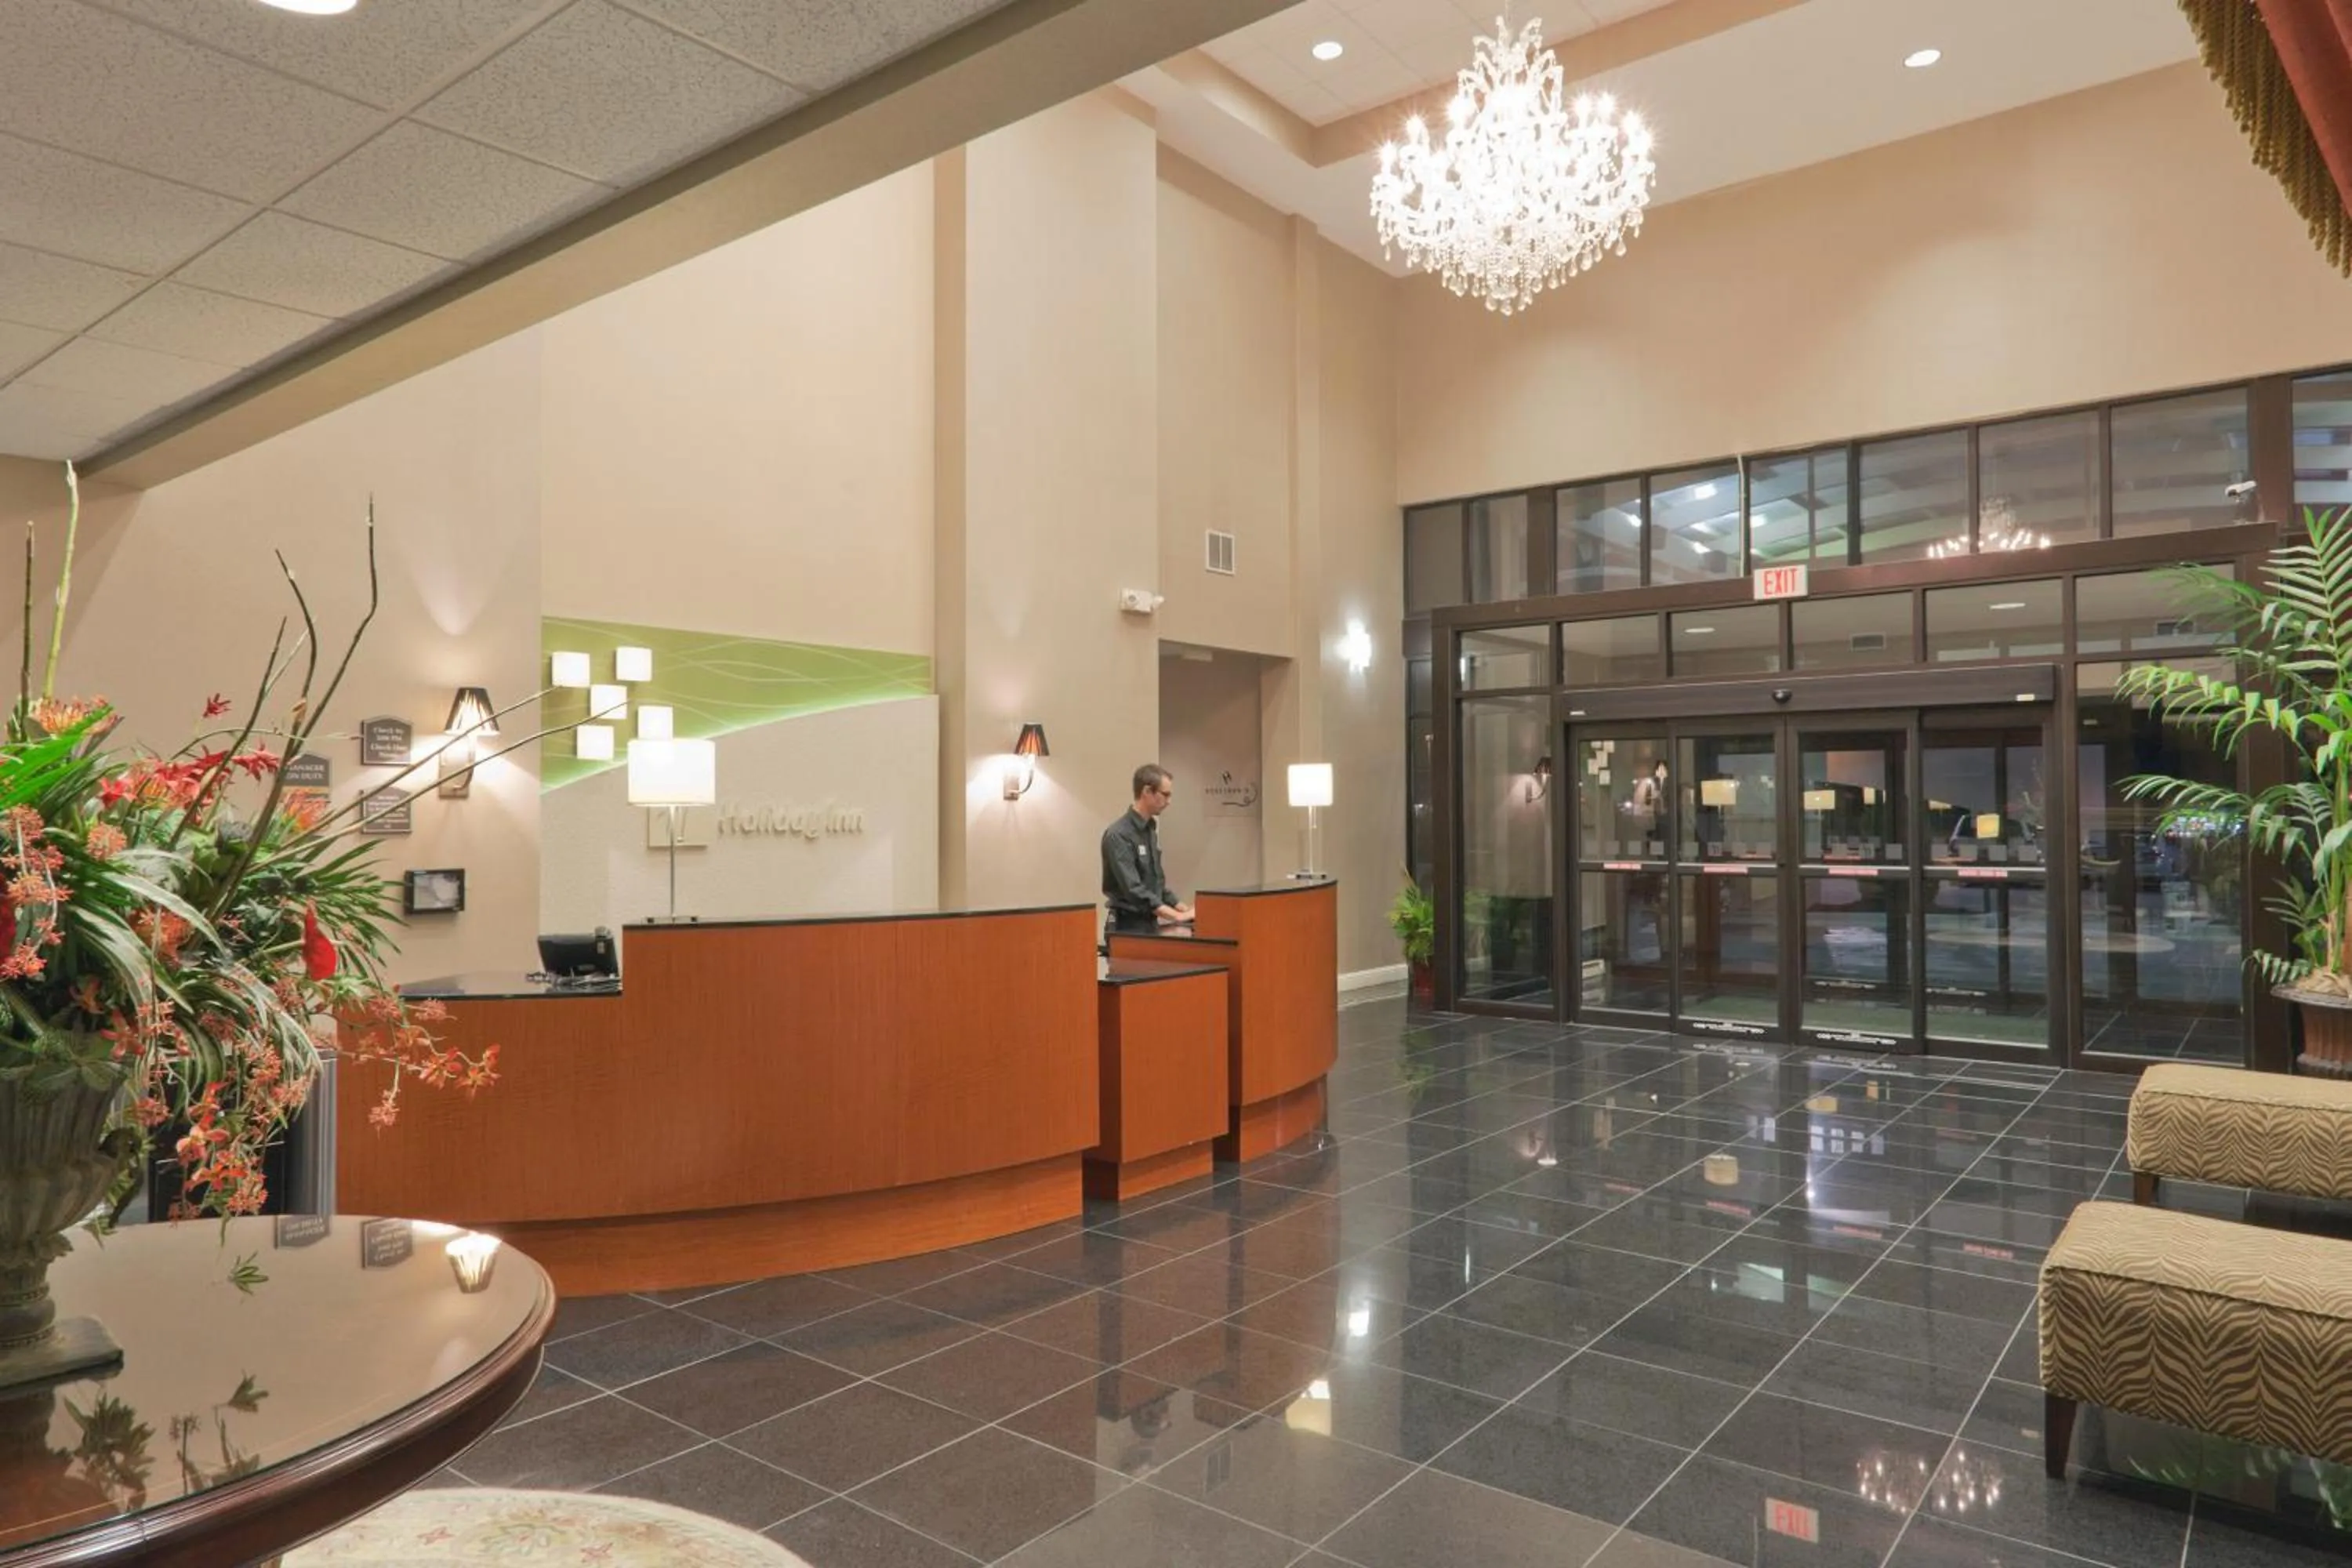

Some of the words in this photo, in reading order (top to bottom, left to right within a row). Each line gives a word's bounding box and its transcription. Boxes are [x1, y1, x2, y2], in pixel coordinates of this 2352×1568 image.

[1763, 567, 1798, 595] EXIT
[717, 801, 820, 841] Holiday
[824, 799, 863, 833] Inn
